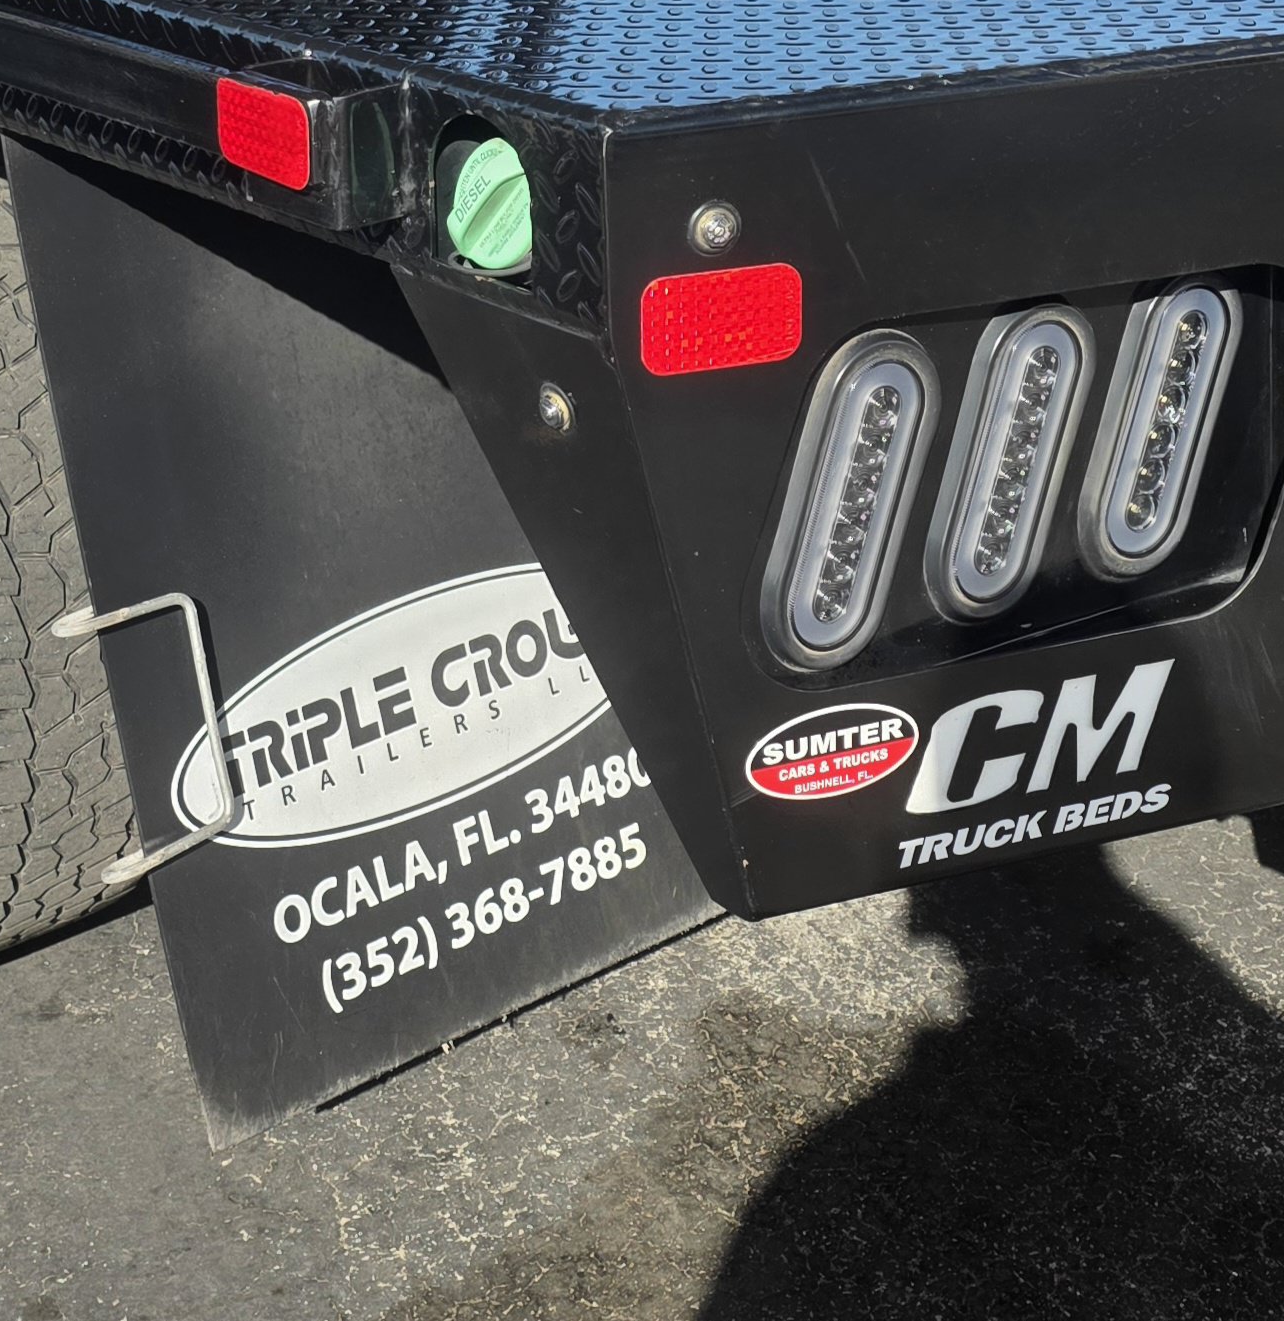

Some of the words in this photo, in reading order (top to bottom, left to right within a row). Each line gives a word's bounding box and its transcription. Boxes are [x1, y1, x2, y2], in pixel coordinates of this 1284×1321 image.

[454, 176, 492, 223] DIESEL
[220, 666, 417, 798] TRIPLE
[242, 699, 501, 821] TRAILERS
[762, 718, 904, 766] SUMTER
[779, 763, 816, 782] CARS
[819, 760, 830, 774] &
[833, 748, 888, 770] TRUCKS
[905, 658, 1176, 815] CM
[794, 774, 855, 795] BUSHNELL,
[898, 809, 1048, 869] TRUCK
[1052, 783, 1172, 835] BEDS
[273, 840, 448, 944] OCALA,
[453, 809, 522, 867] FL.
[322, 916, 439, 1014] (352)
[444, 822, 647, 950] 368-7885
